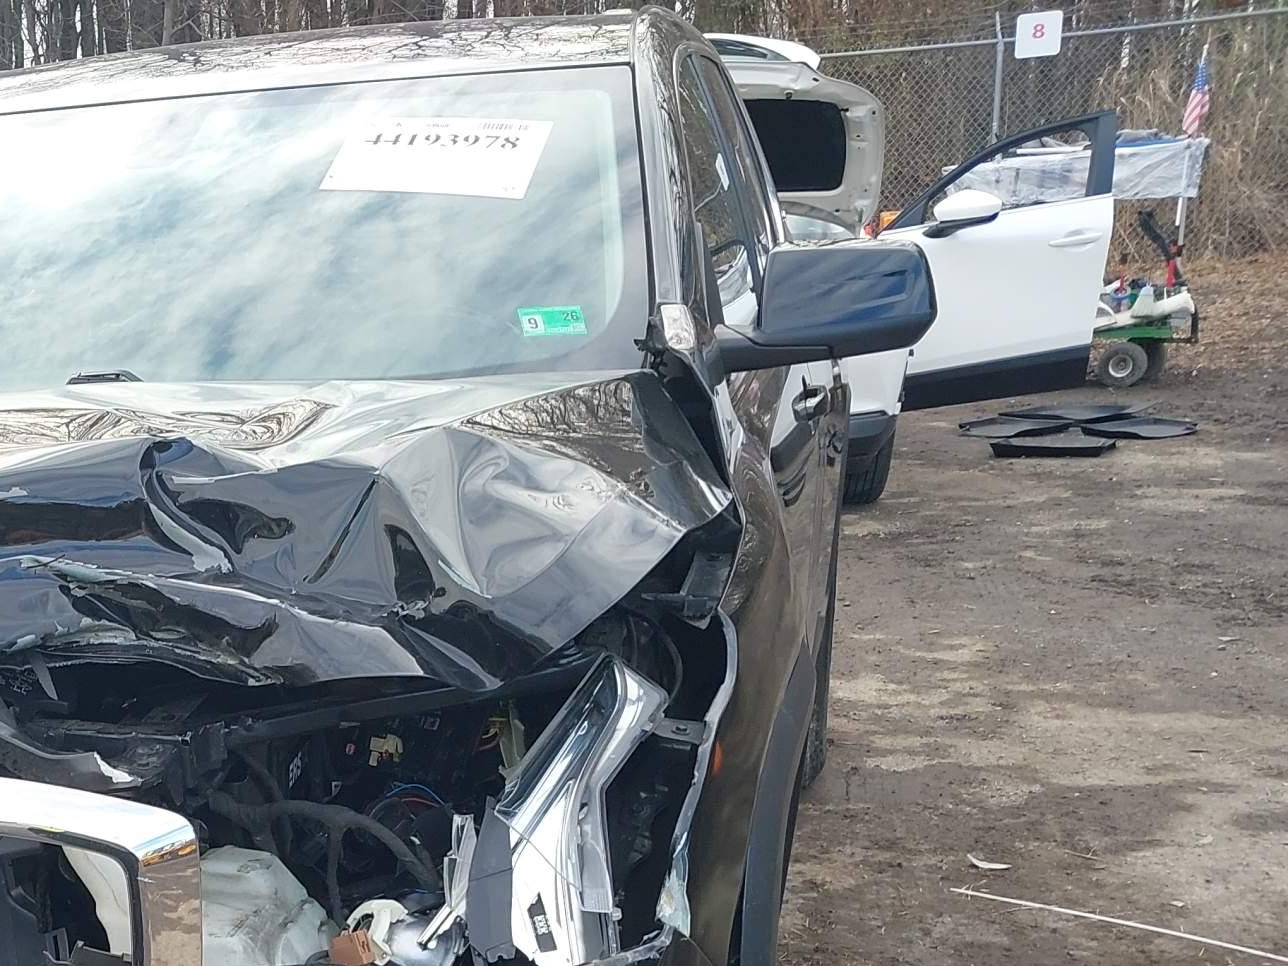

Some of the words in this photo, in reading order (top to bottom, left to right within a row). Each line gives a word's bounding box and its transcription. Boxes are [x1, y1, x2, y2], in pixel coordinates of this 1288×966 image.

[1032, 23, 1045, 38] 8
[364, 132, 521, 149] 44193978
[528, 317, 539, 329] 9
